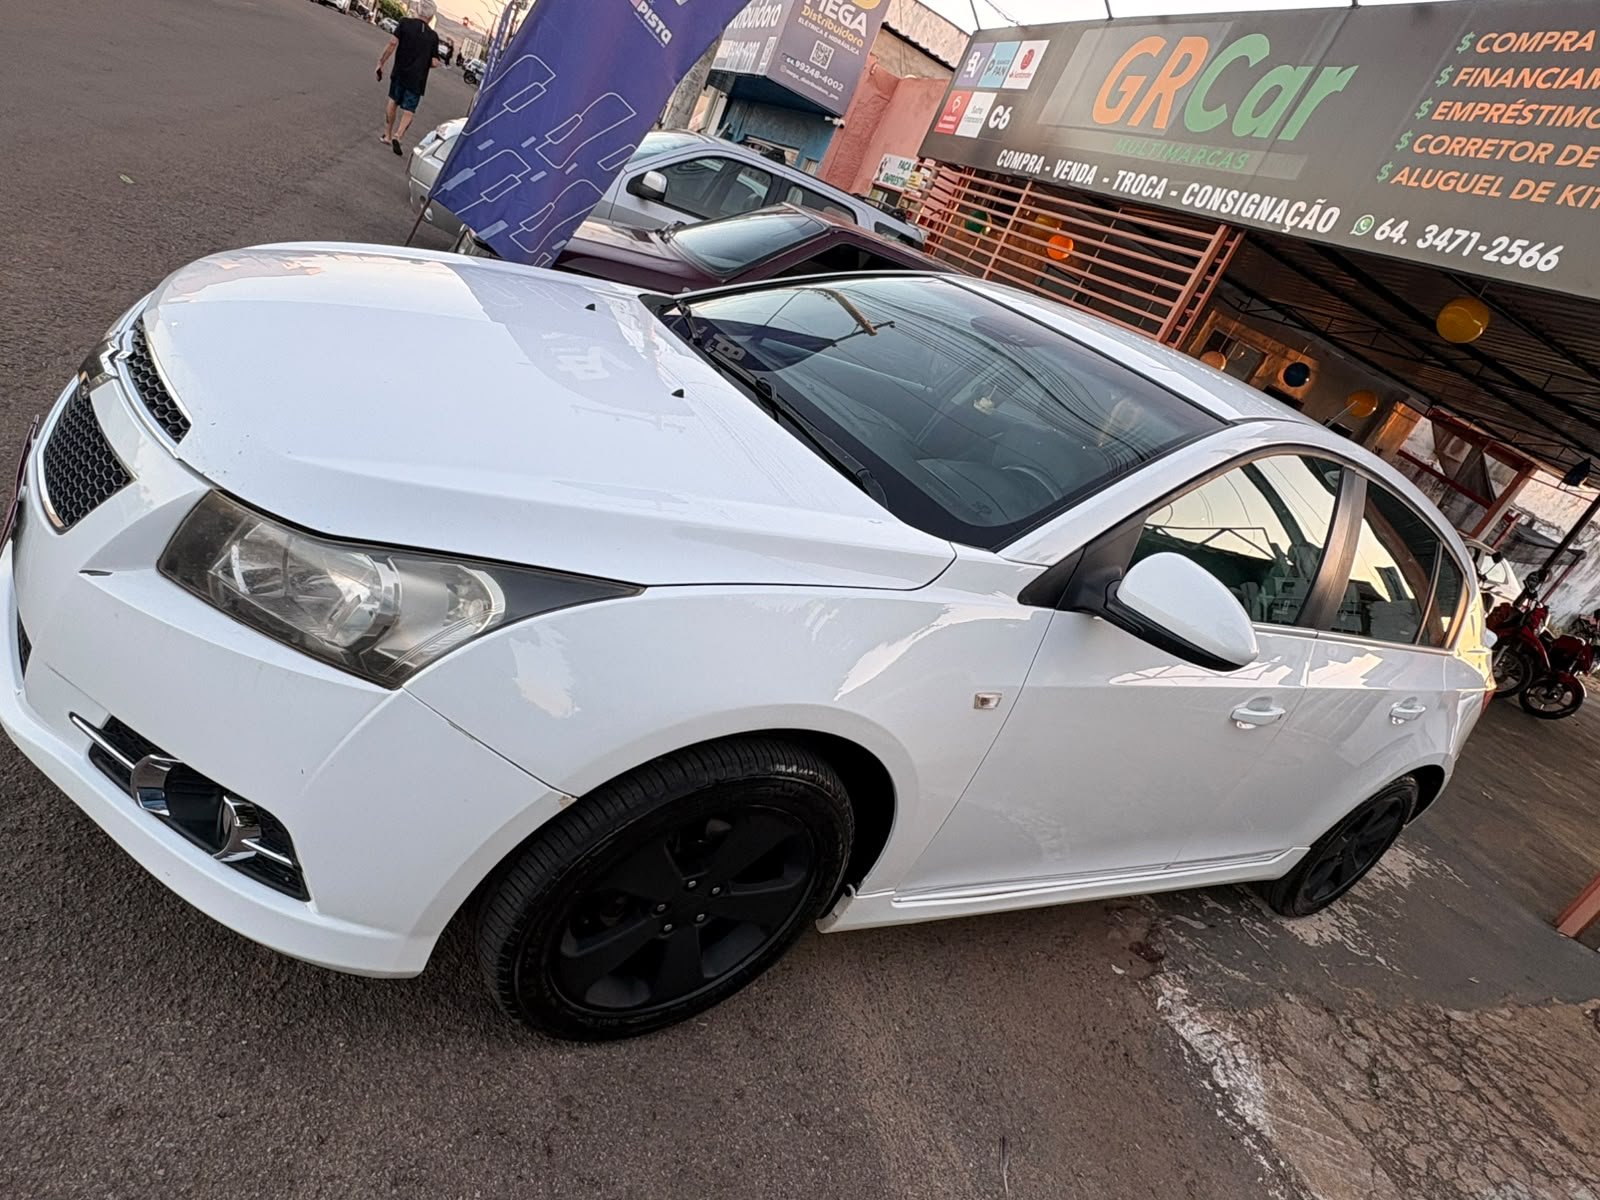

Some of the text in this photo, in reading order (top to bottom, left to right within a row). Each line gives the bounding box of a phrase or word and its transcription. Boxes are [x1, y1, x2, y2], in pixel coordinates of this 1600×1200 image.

[801, 5, 864, 48] Distribuidora
[1475, 30, 1596, 53] COMPRA
[989, 105, 1013, 130] C6
[1432, 98, 1600, 129] EMPRÉSTIMO
[1114, 138, 1249, 171] MULTIMARCAS
[1413, 133, 1554, 164] CORRETOR
[1555, 144, 1600, 169] DE
[996, 149, 1044, 175] COMPRA
[1052, 159, 1097, 185] VENDA
[1112, 170, 1169, 199] TROCA
[1181, 183, 1341, 234] CONSIGNAÇÃO
[1390, 166, 1504, 198] ALUGUEL
[1509, 178, 1556, 203] DE
[1374, 217, 1564, 272] 64. 3471-2566
